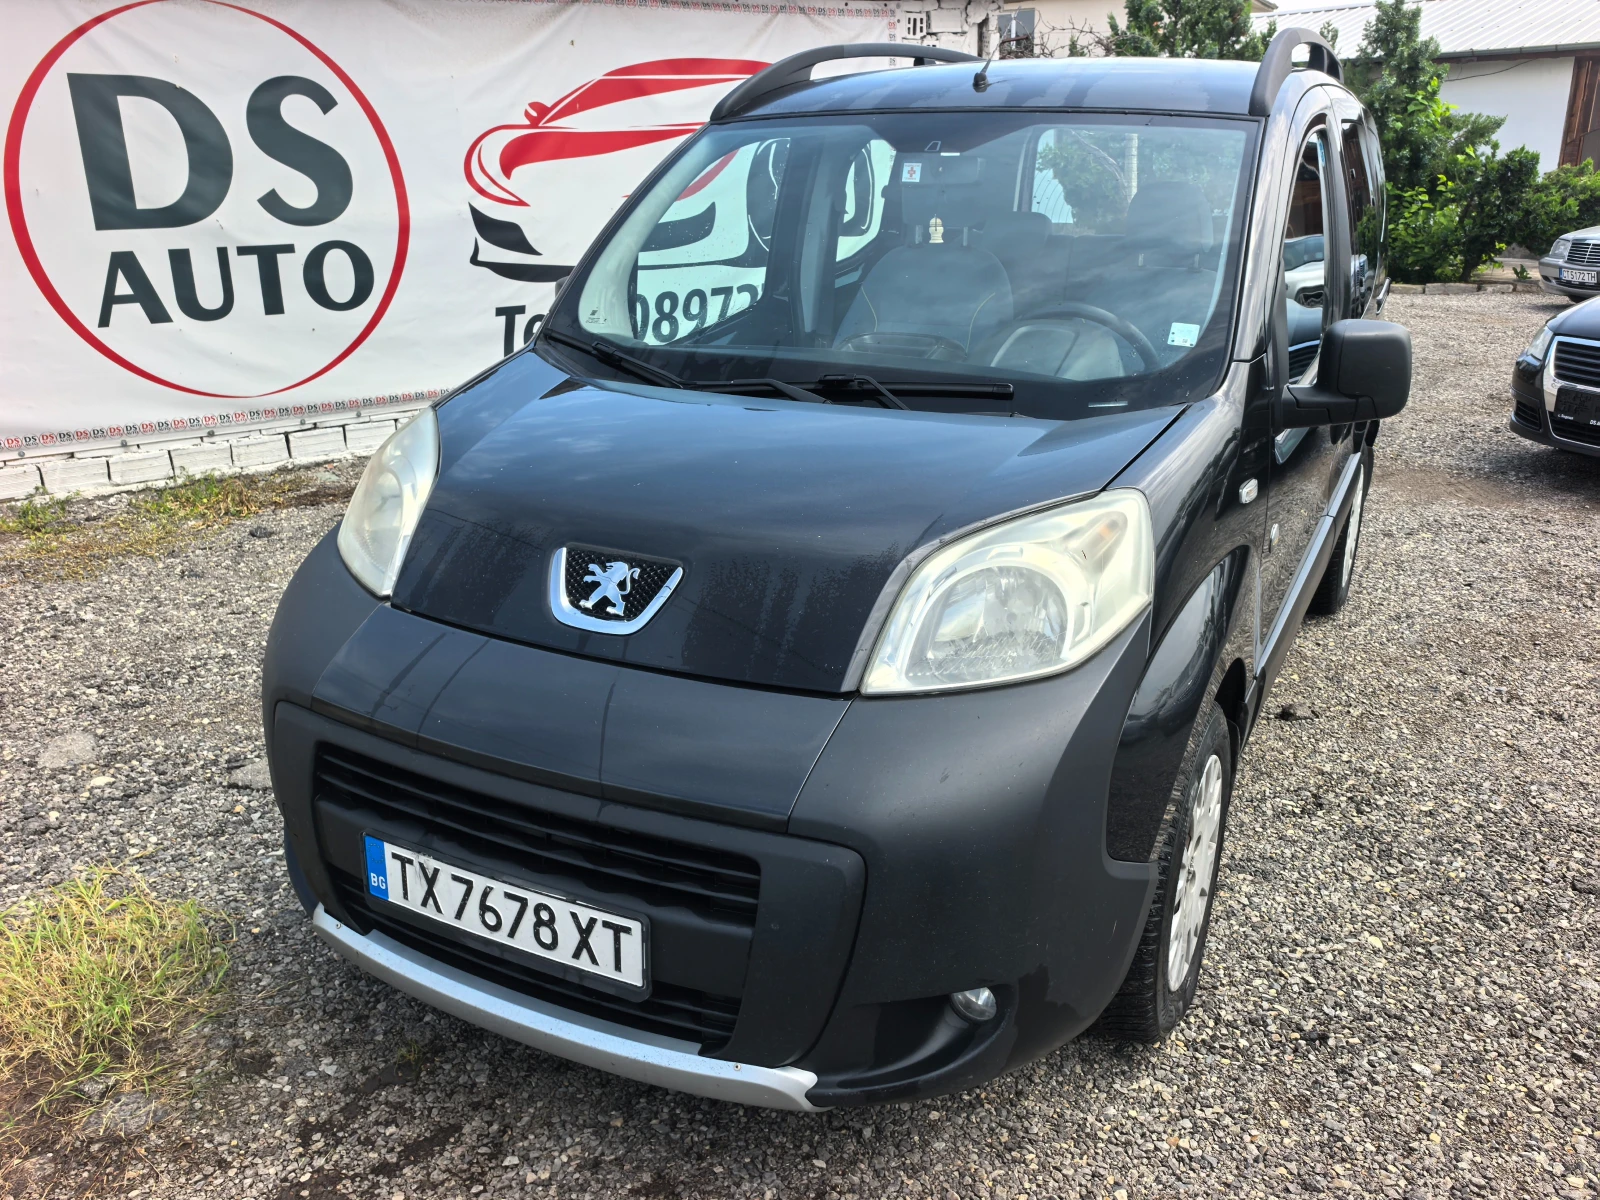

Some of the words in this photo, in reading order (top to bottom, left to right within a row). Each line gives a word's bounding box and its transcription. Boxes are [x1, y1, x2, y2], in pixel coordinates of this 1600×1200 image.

[66, 72, 353, 231] DS
[97, 239, 375, 328] AUTO
[494, 304, 546, 358] Te
[7, 438, 20, 446] DS
[370, 872, 386, 890] BG
